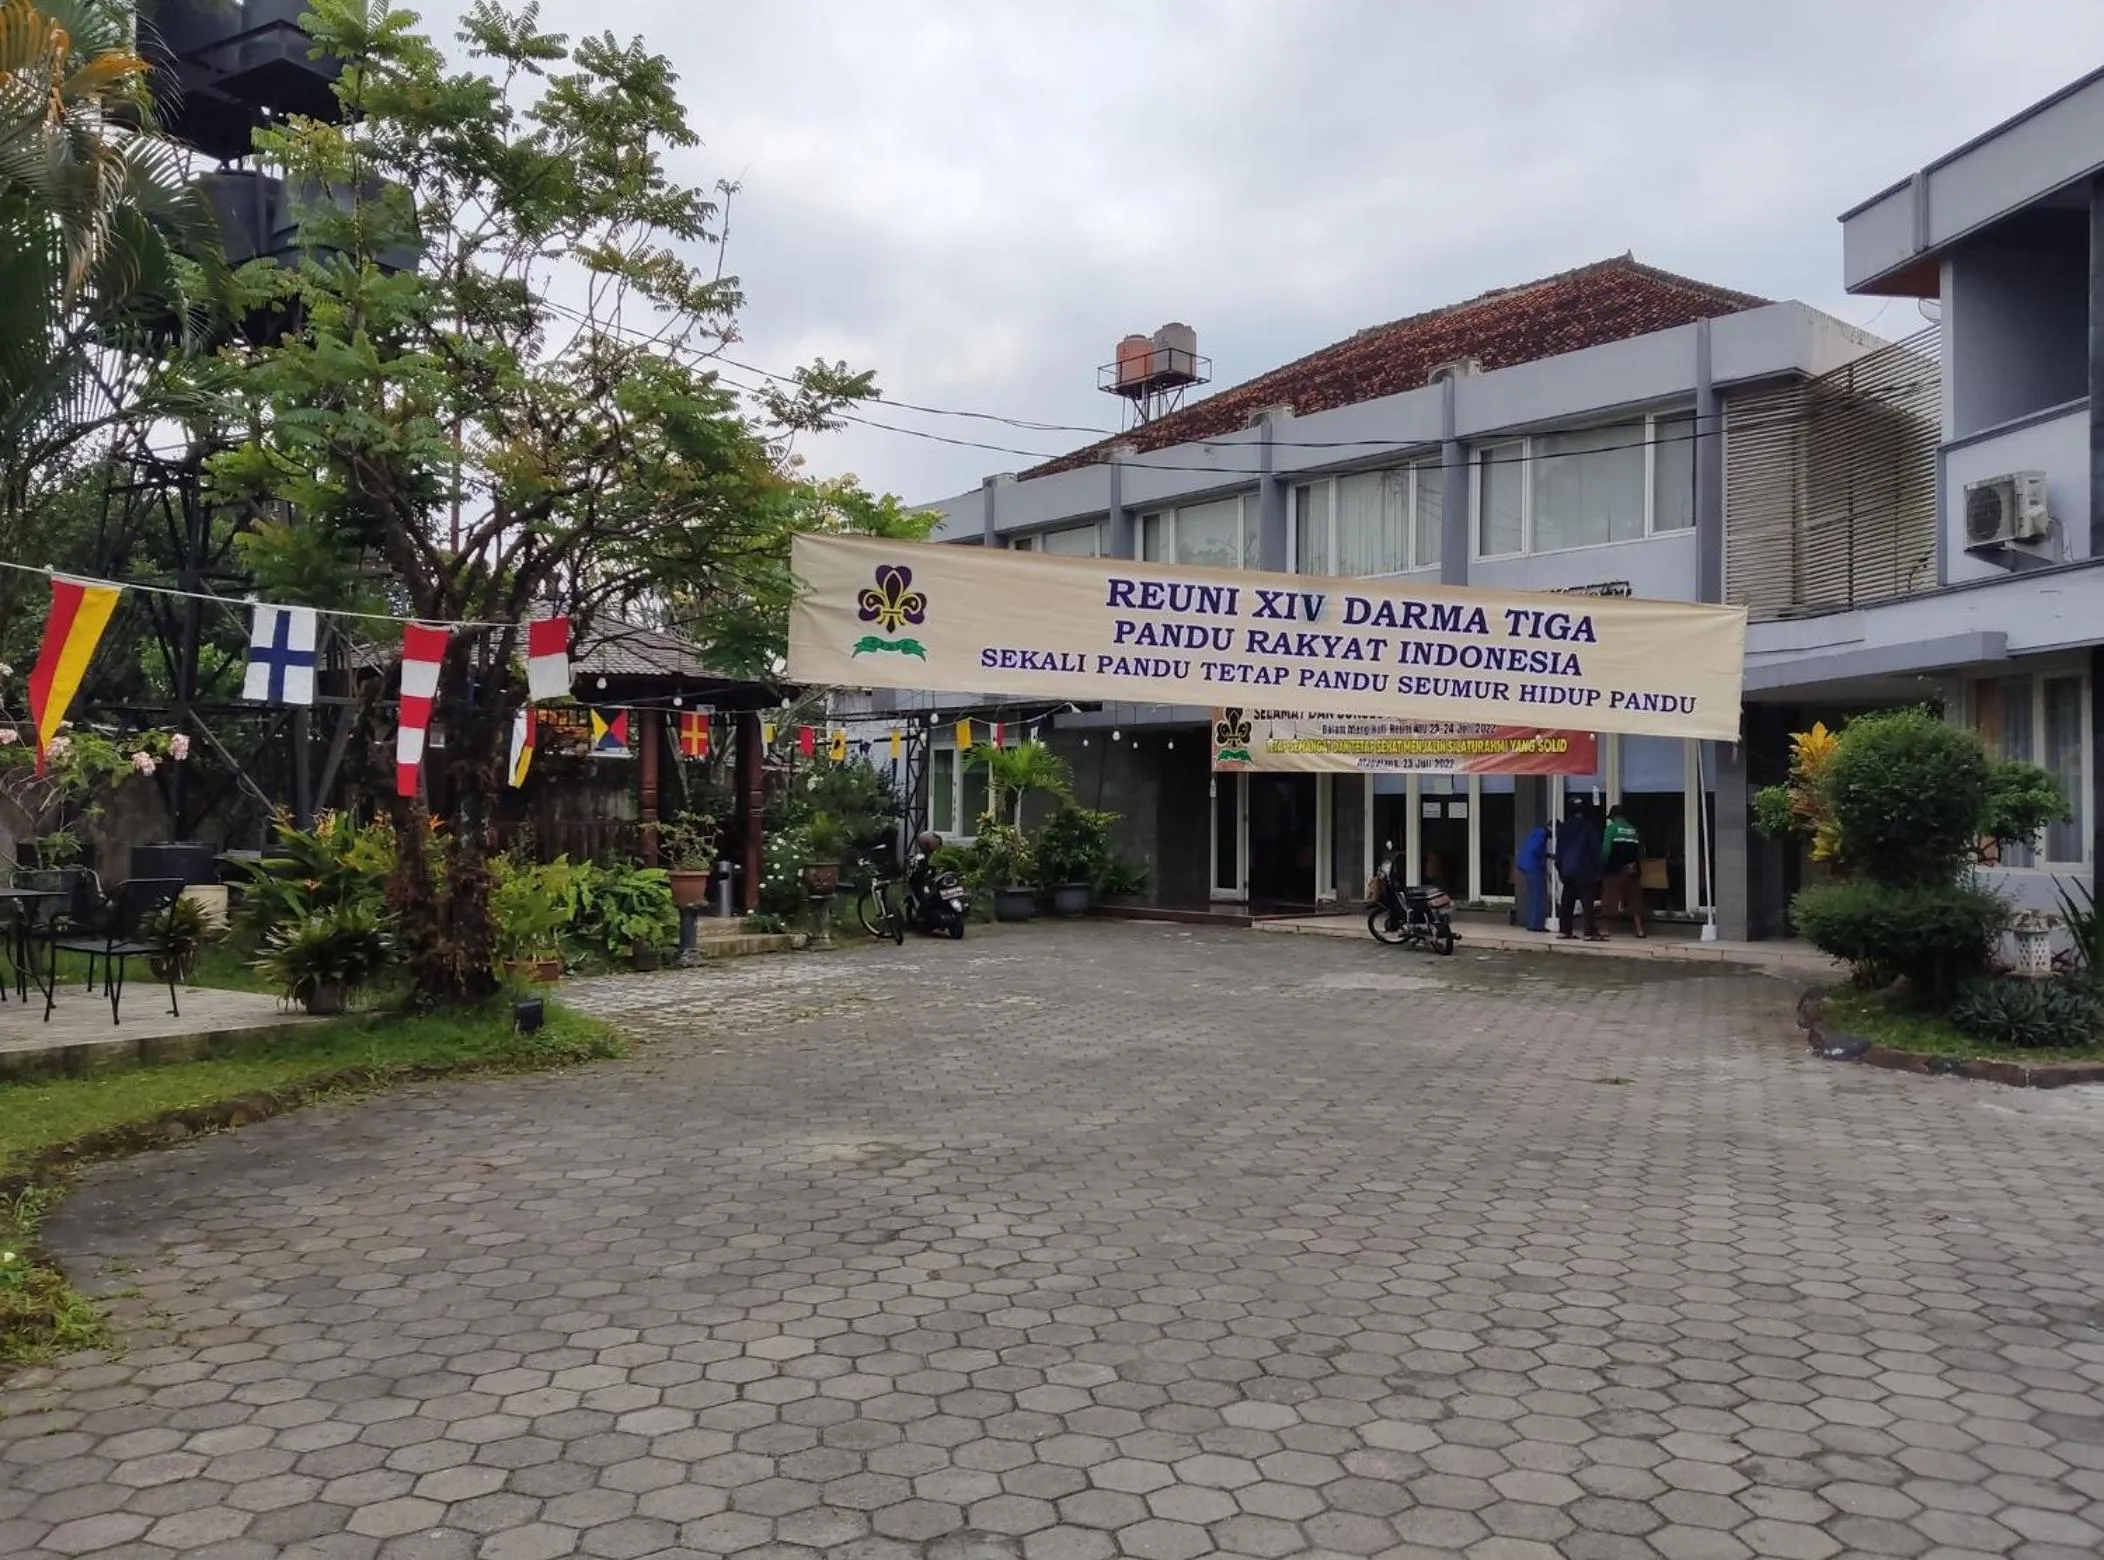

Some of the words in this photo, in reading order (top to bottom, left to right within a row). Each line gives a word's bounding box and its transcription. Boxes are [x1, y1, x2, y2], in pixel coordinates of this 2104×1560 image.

[1106, 578, 1240, 617] REUNI
[1251, 589, 1326, 623] XIV
[1342, 597, 1490, 635] DARMA
[1504, 608, 1597, 643] TIGA
[1112, 619, 1236, 654] PANDU
[1244, 629, 1389, 662] RAKYAT
[1397, 640, 1583, 677] INDONESIA
[981, 647, 1087, 673] SEKALI
[1095, 654, 1191, 681] PANDU
[1199, 661, 1290, 687] TETAP
[1297, 668, 1390, 693] PANDU
[1397, 675, 1510, 701] SEUMUR
[1518, 683, 1602, 708] HIDUP
[1608, 690, 1697, 715] PANDU
[1475, 723, 1496, 735] 2022
[1510, 738, 1535, 753] YANG
[1537, 738, 1568, 753] SOLID
[1403, 758, 1414, 769] 23
